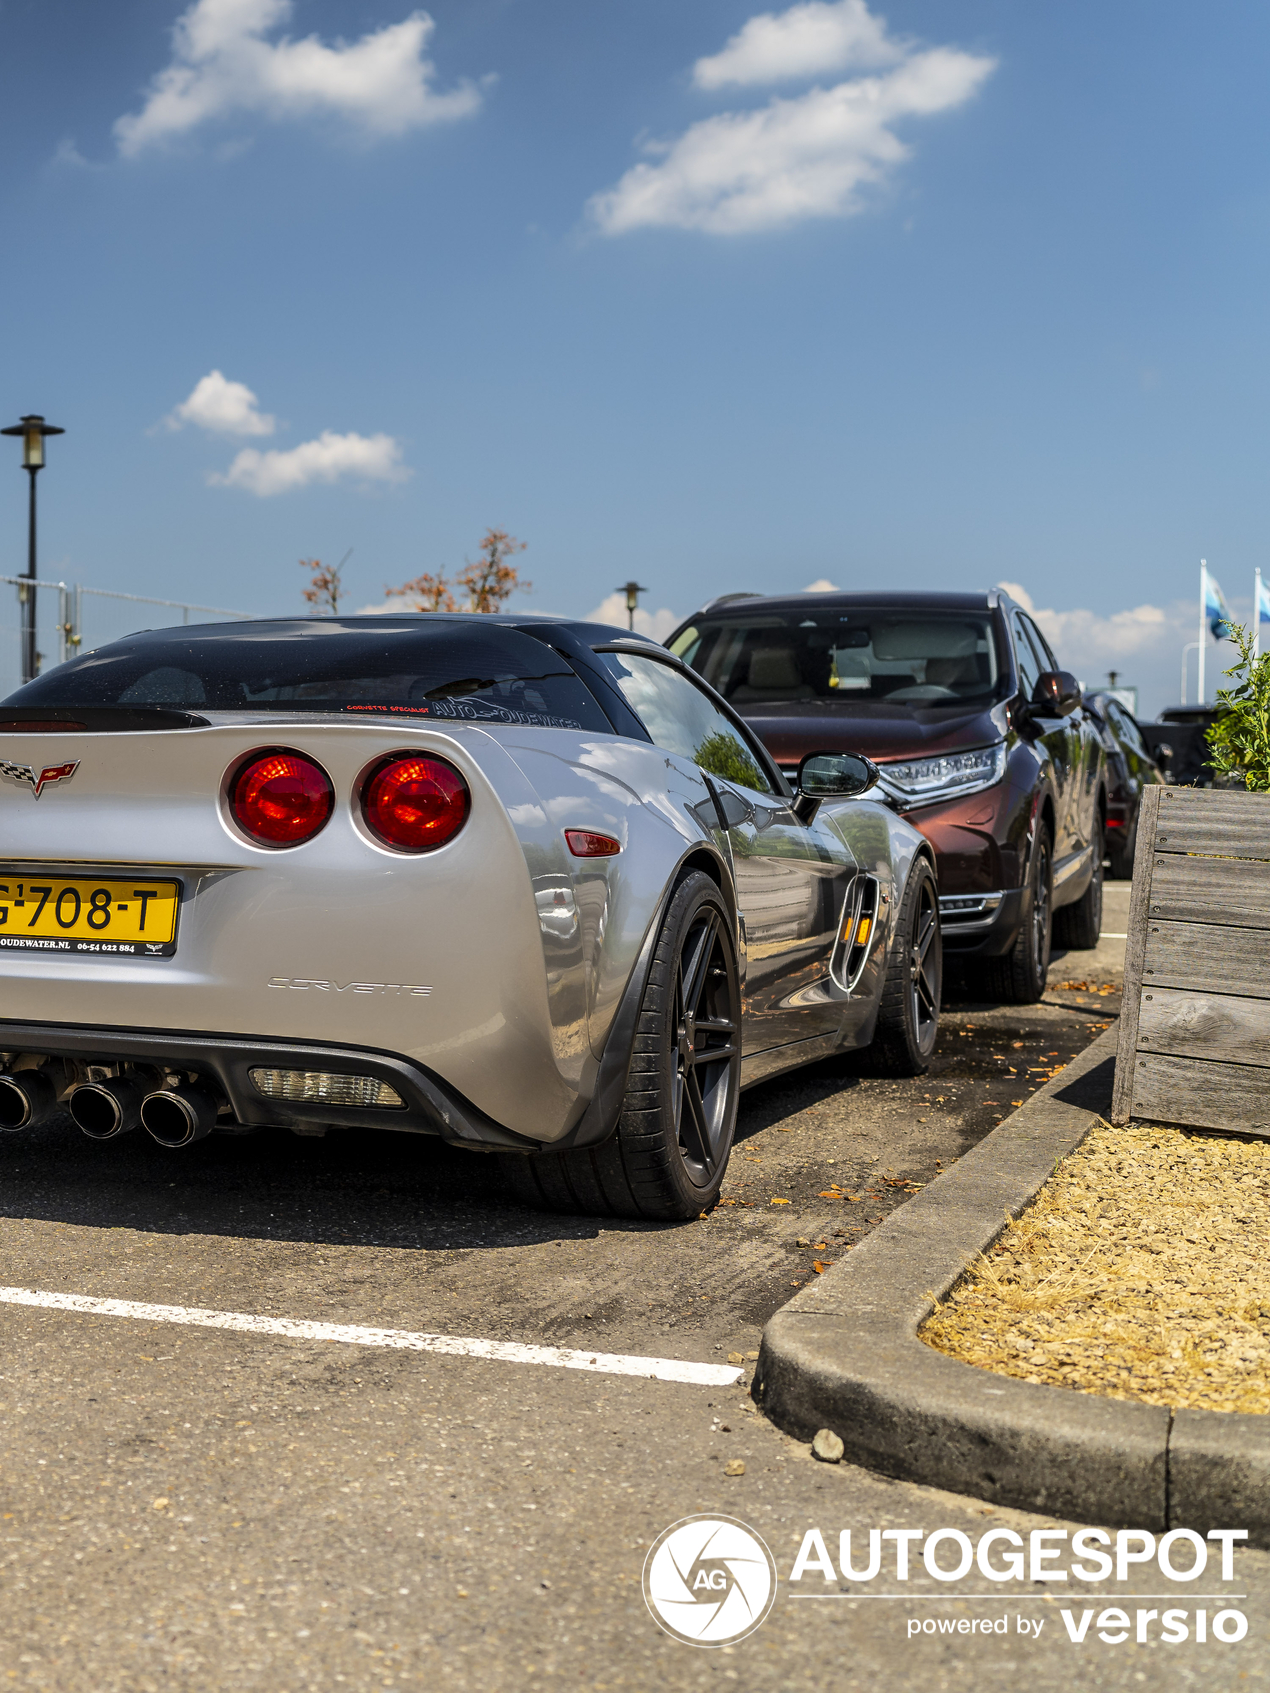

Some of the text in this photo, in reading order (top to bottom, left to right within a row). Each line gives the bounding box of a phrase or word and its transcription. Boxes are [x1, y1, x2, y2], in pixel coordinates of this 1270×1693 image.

[432, 701, 478, 719] AUTO
[101, 943, 118, 952] 622
[118, 944, 135, 953] 884
[267, 976, 433, 997] CORVETTE
